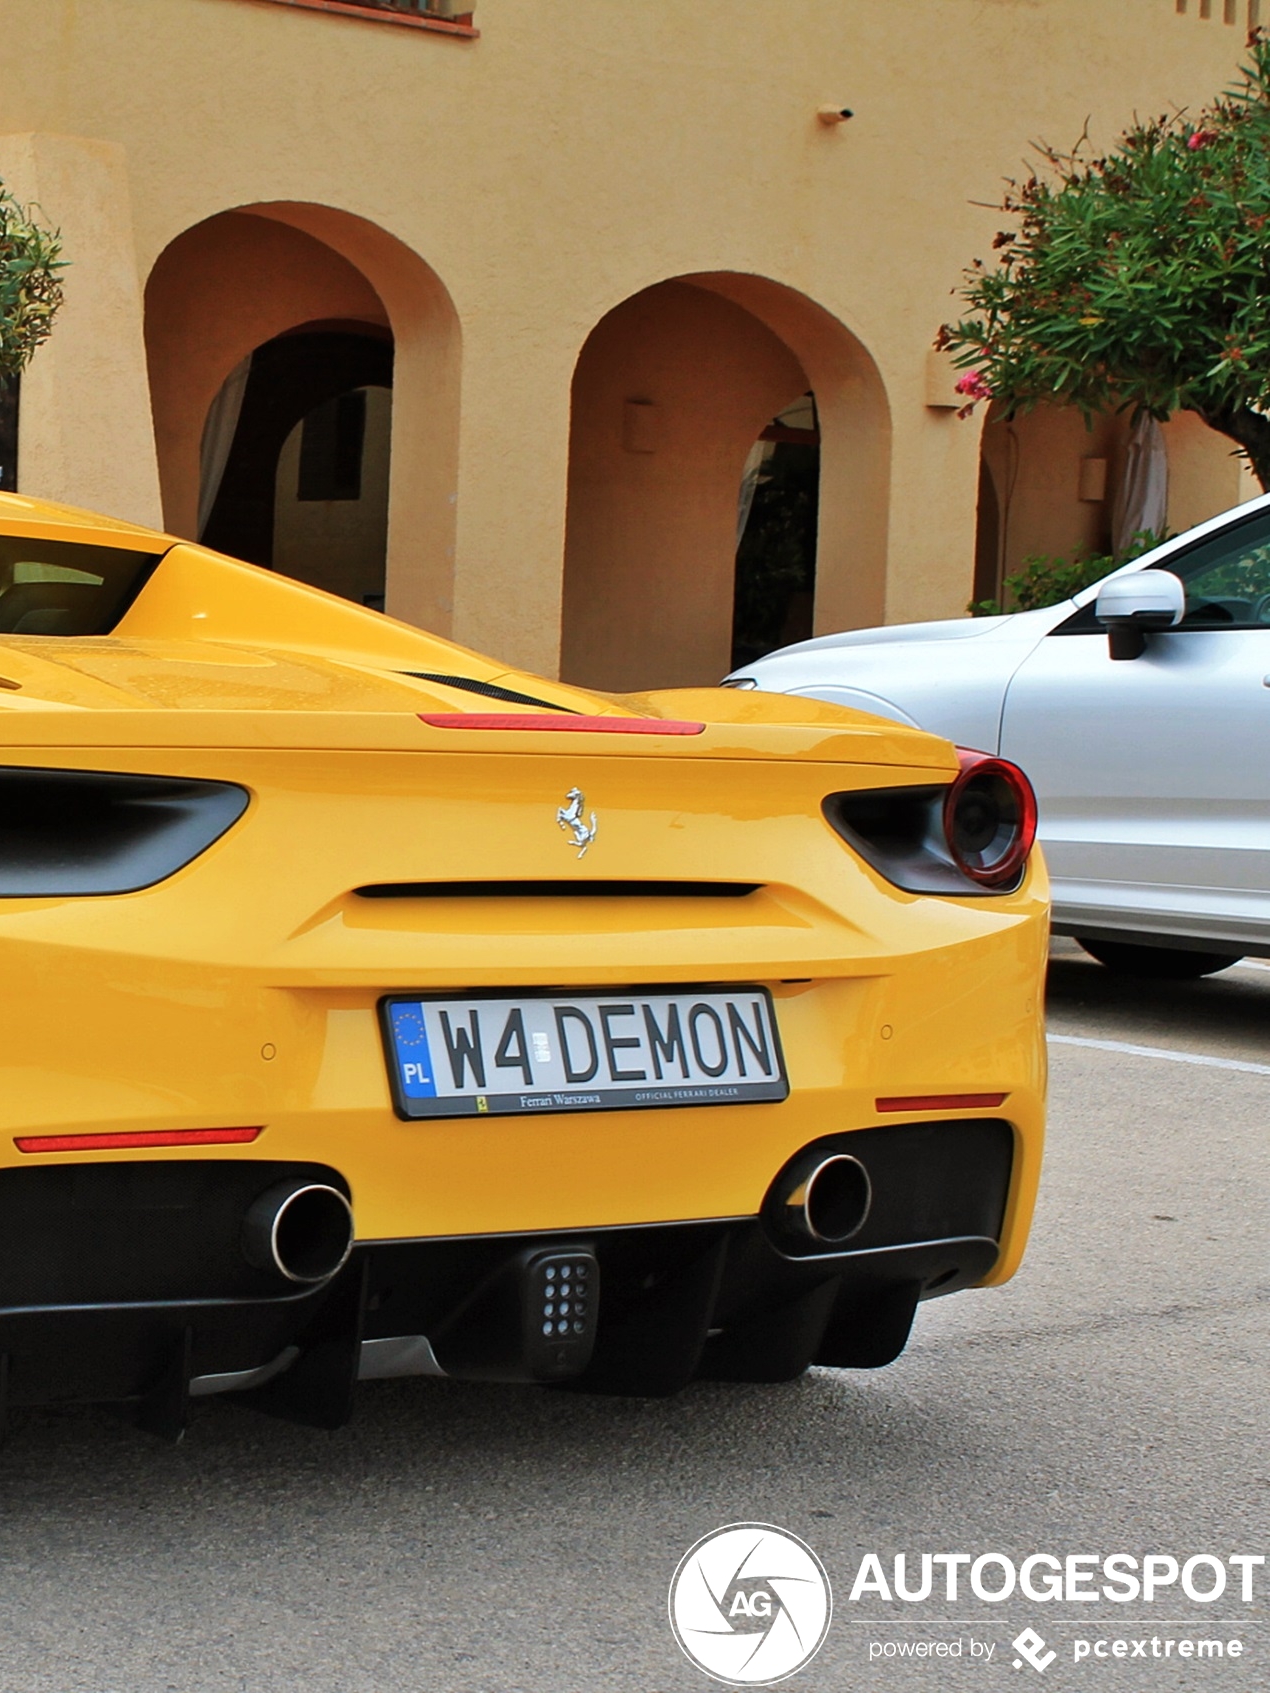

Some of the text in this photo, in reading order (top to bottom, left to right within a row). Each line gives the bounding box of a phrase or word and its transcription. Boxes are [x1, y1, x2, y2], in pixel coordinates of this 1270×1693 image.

[438, 1002, 773, 1089] W4 DEMON
[404, 1062, 430, 1085] PL
[520, 1093, 601, 1108] Ferrari Warszawa
[635, 1087, 739, 1101] OFFICIAL FERRARI DEALER
